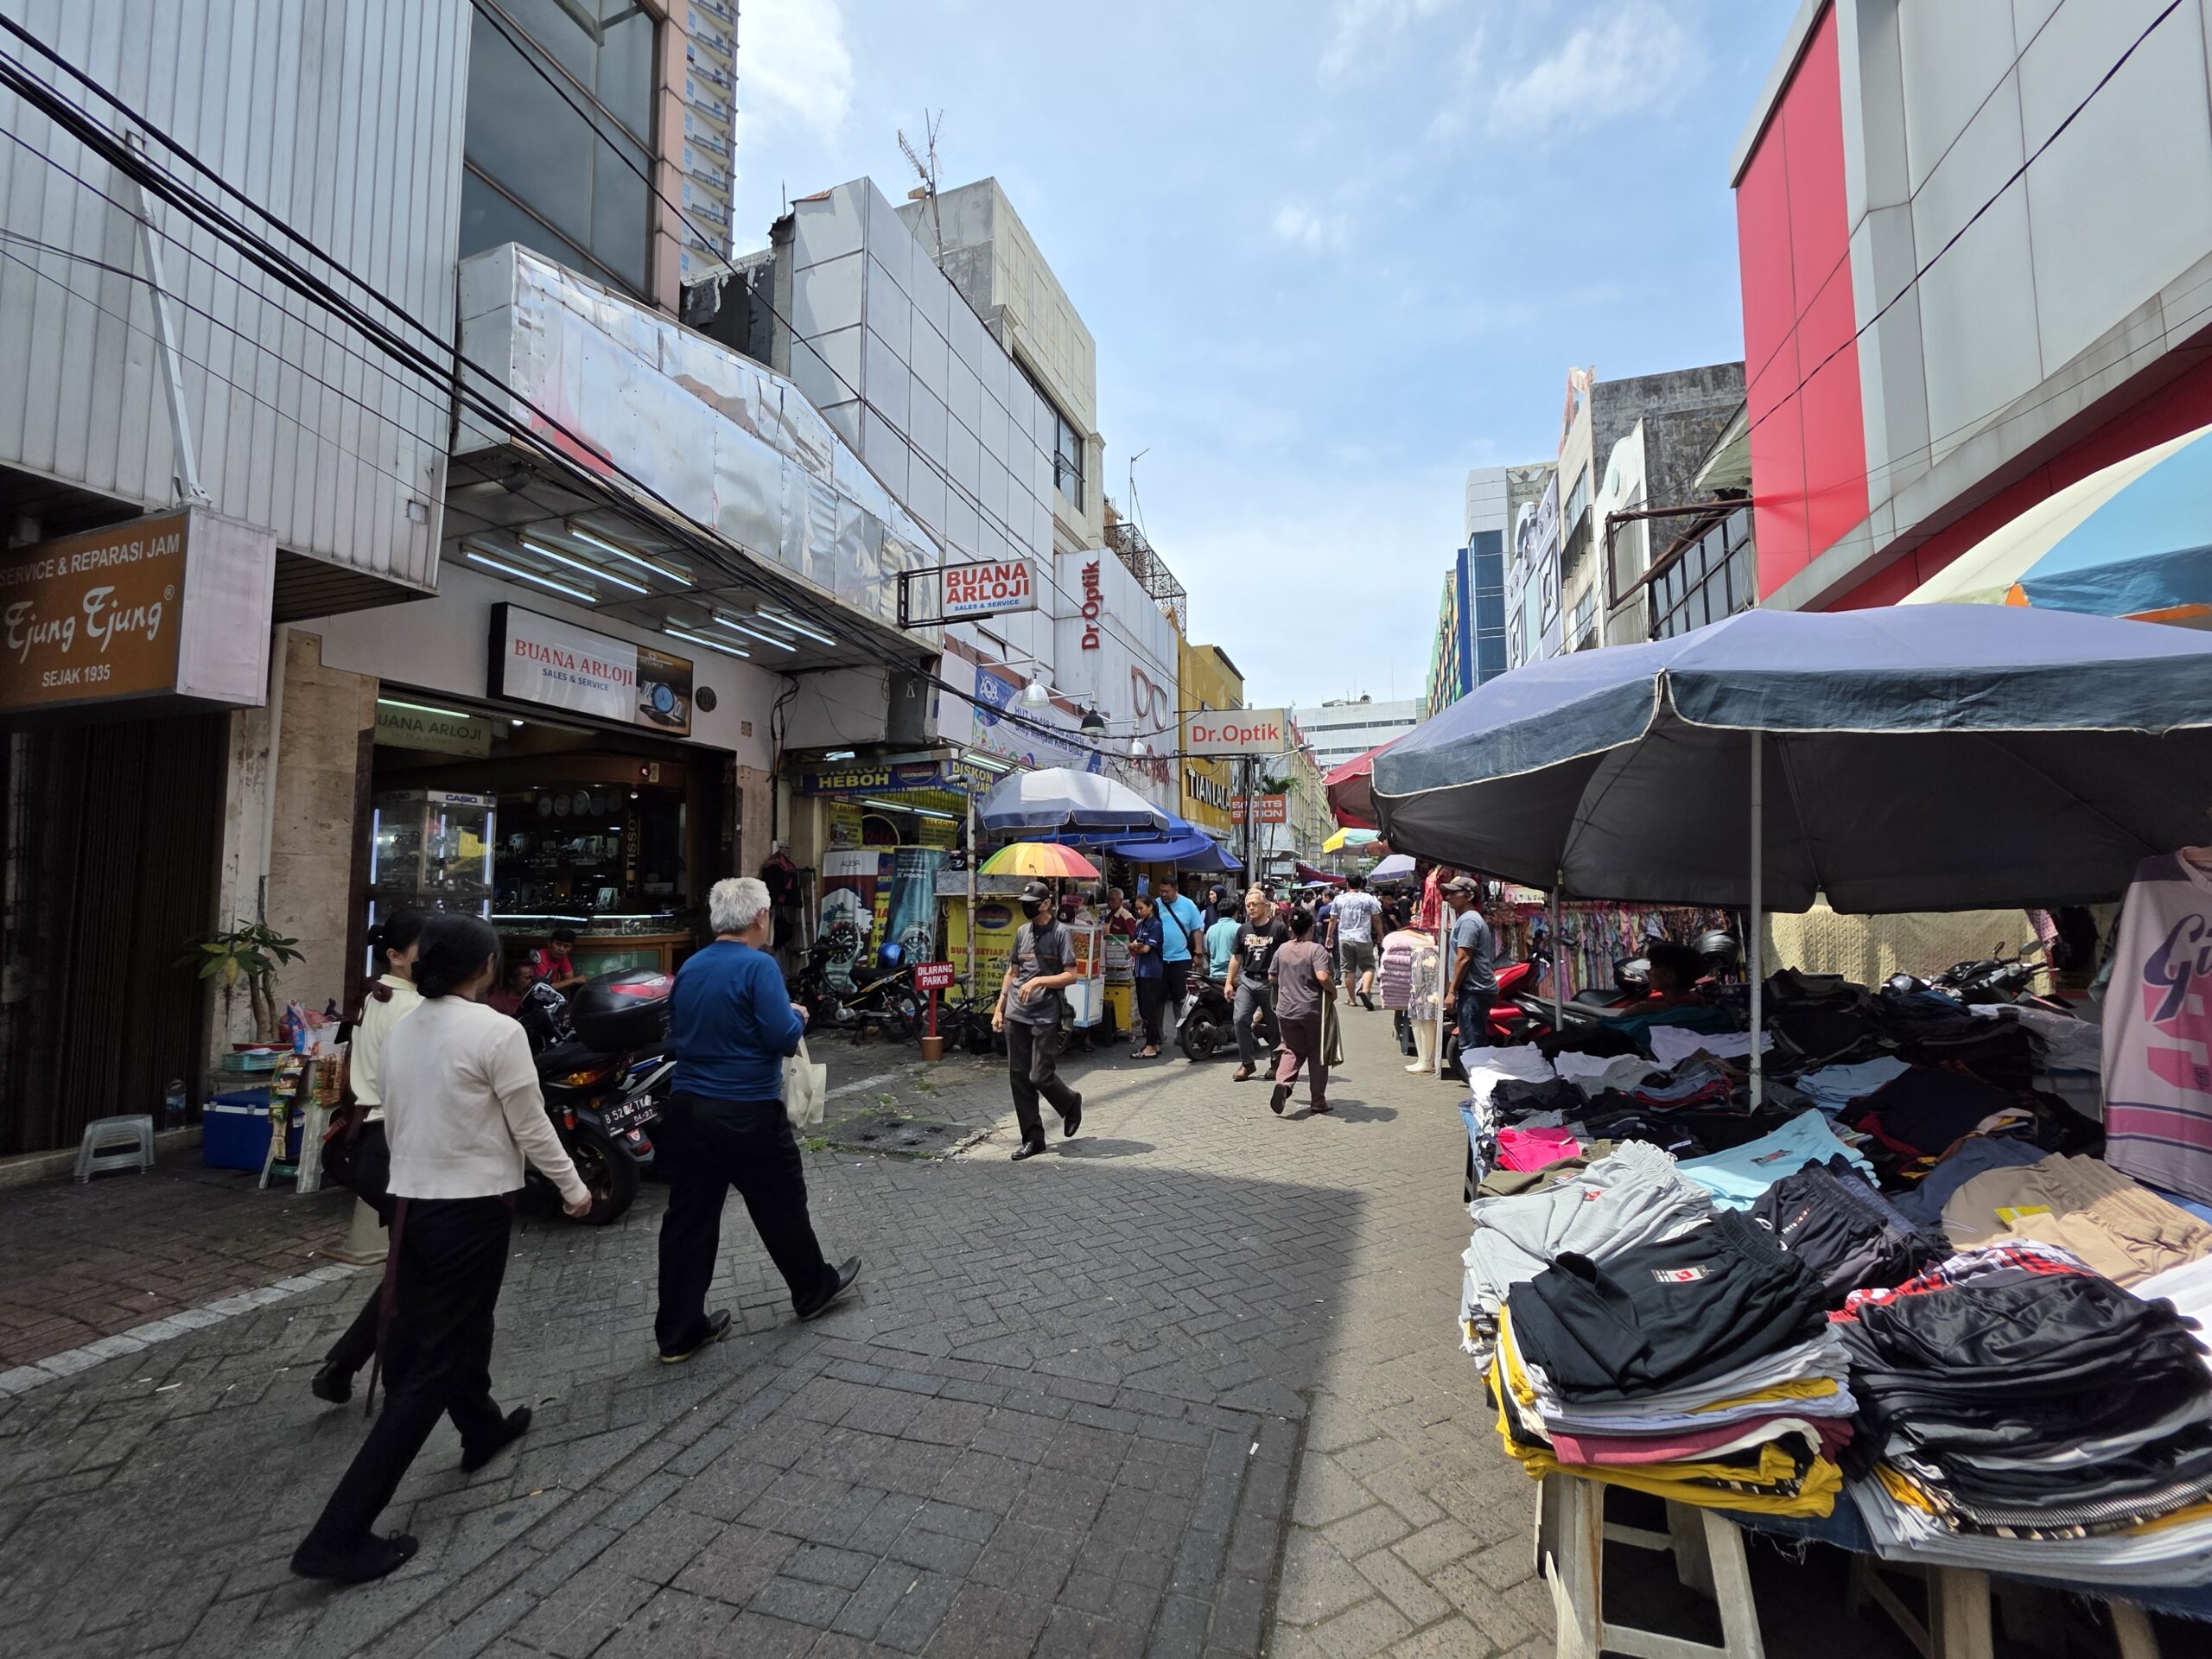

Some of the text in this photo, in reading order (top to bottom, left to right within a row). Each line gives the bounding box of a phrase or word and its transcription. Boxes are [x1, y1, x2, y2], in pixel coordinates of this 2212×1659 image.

[0, 533, 181, 586] SERVICE & REPARASI JAM
[946, 563, 1028, 588] BUANA
[946, 579, 1029, 604] ARLOJI
[988, 599, 1020, 607] SERVICE
[1082, 560, 1103, 650] Dr Optik
[514, 639, 633, 687] BUANA ARLOJI
[41, 664, 111, 688] SEJAK 1935
[542, 668, 609, 691] SALES & SERVICE
[429, 721, 481, 741] ARLOJI
[1192, 723, 1280, 746] Dr.Optik
[818, 772, 889, 789] HEBOH
[952, 761, 994, 783] DISKON
[446, 794, 478, 803] CASIO
[1232, 810, 1283, 818] STION
[918, 963, 953, 976] DILARANG
[922, 975, 949, 986] PARKIR
